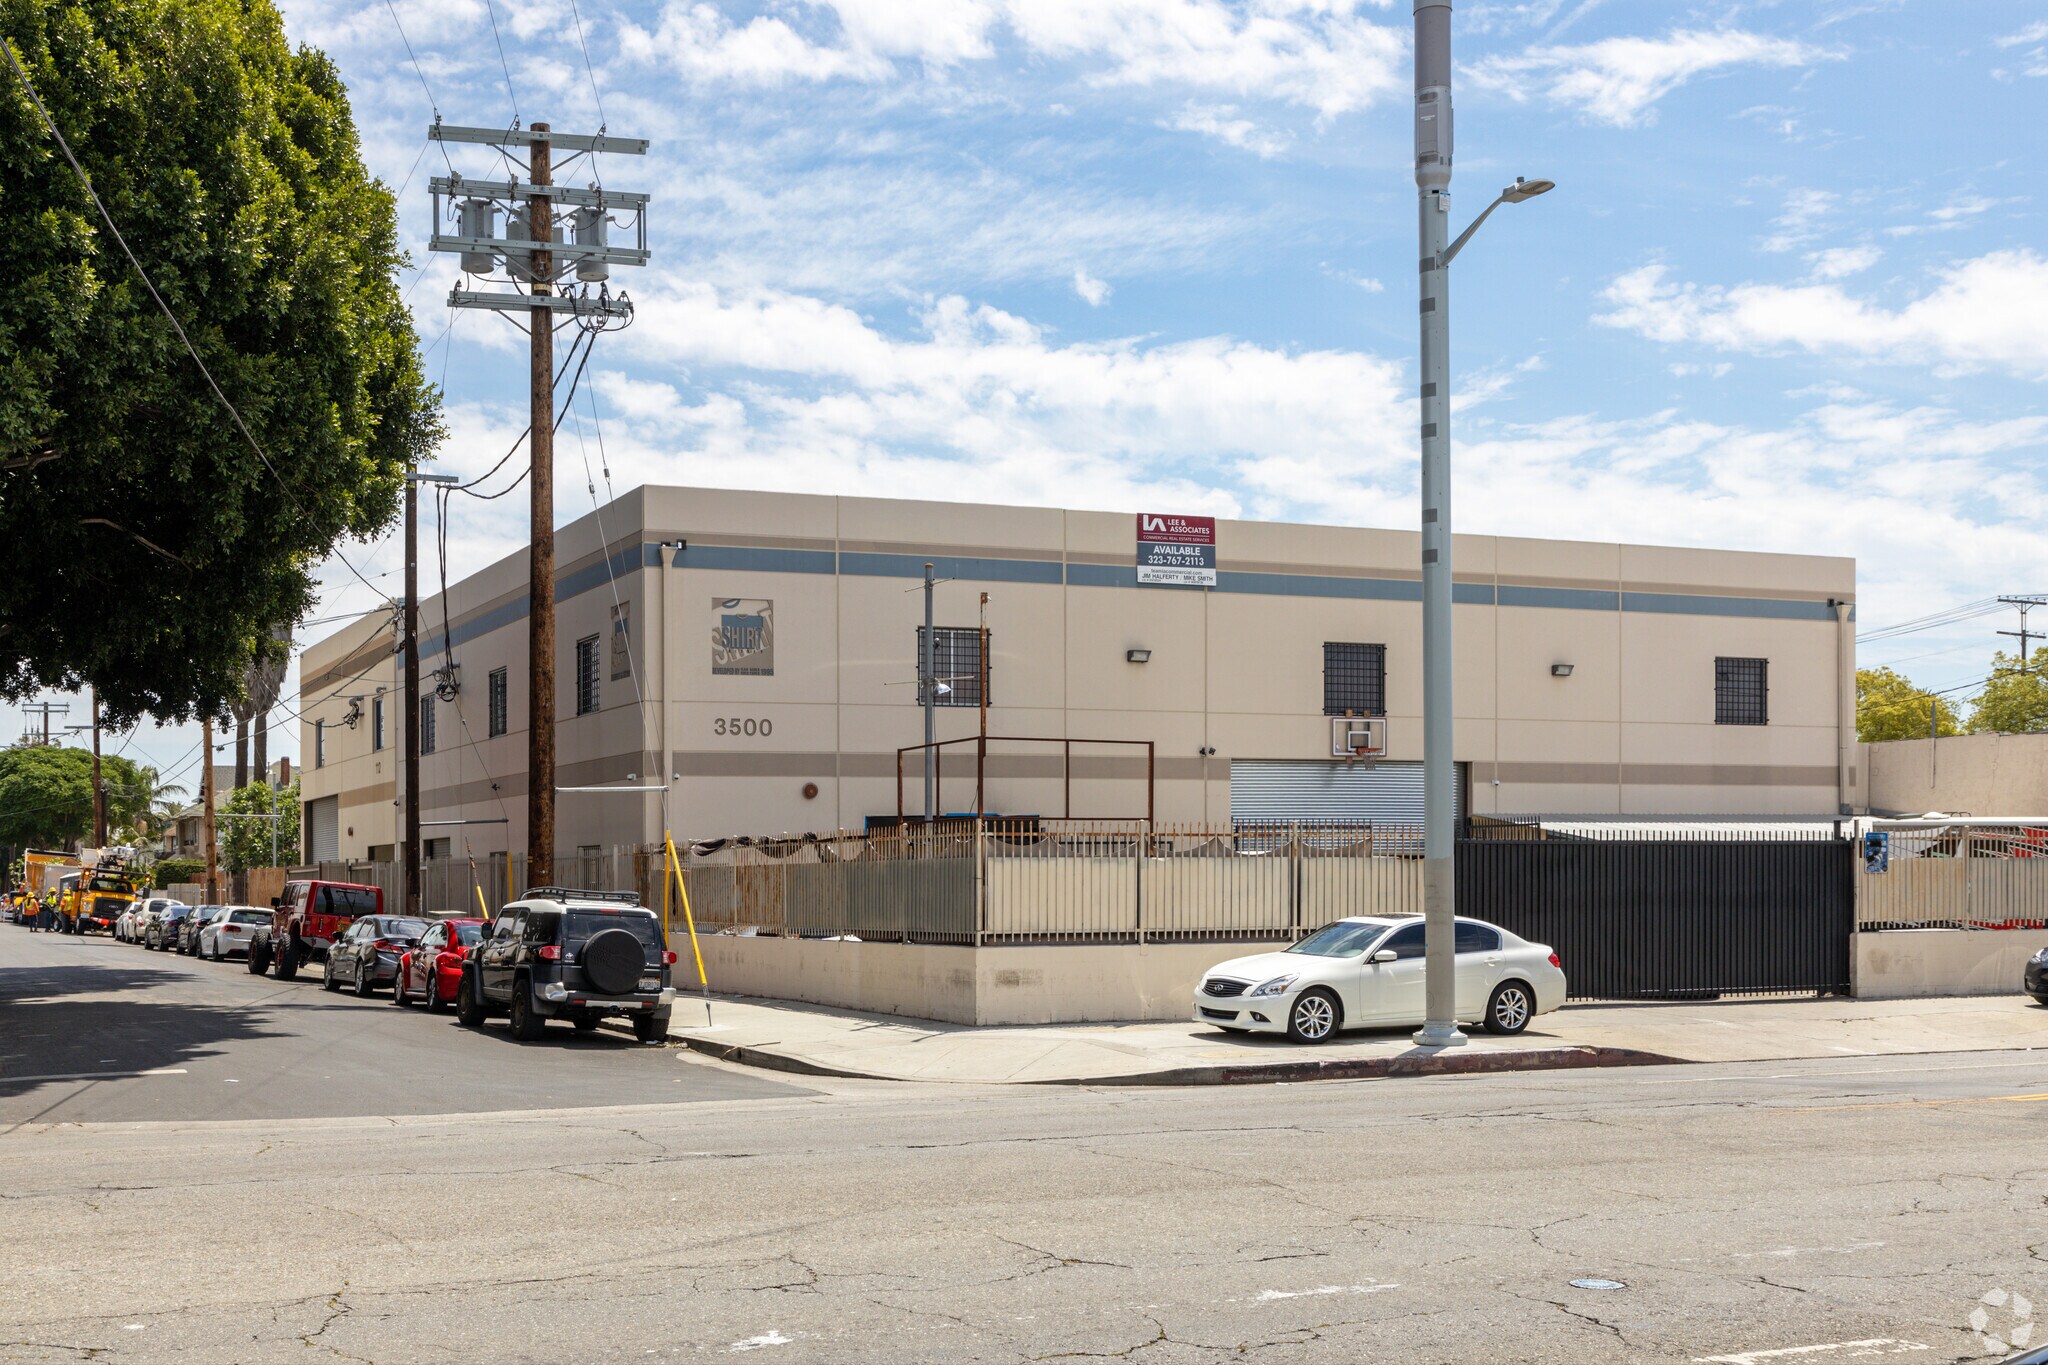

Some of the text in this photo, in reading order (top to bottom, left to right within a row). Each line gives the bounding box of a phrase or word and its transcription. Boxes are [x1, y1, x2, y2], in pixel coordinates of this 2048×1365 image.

[1170, 526, 1210, 534] ASSOCIATES
[1154, 546, 1200, 555] AVAILABLE
[1148, 556, 1204, 566] 323-767-2113
[722, 626, 762, 650] SHIRT
[714, 718, 772, 736] 3500
